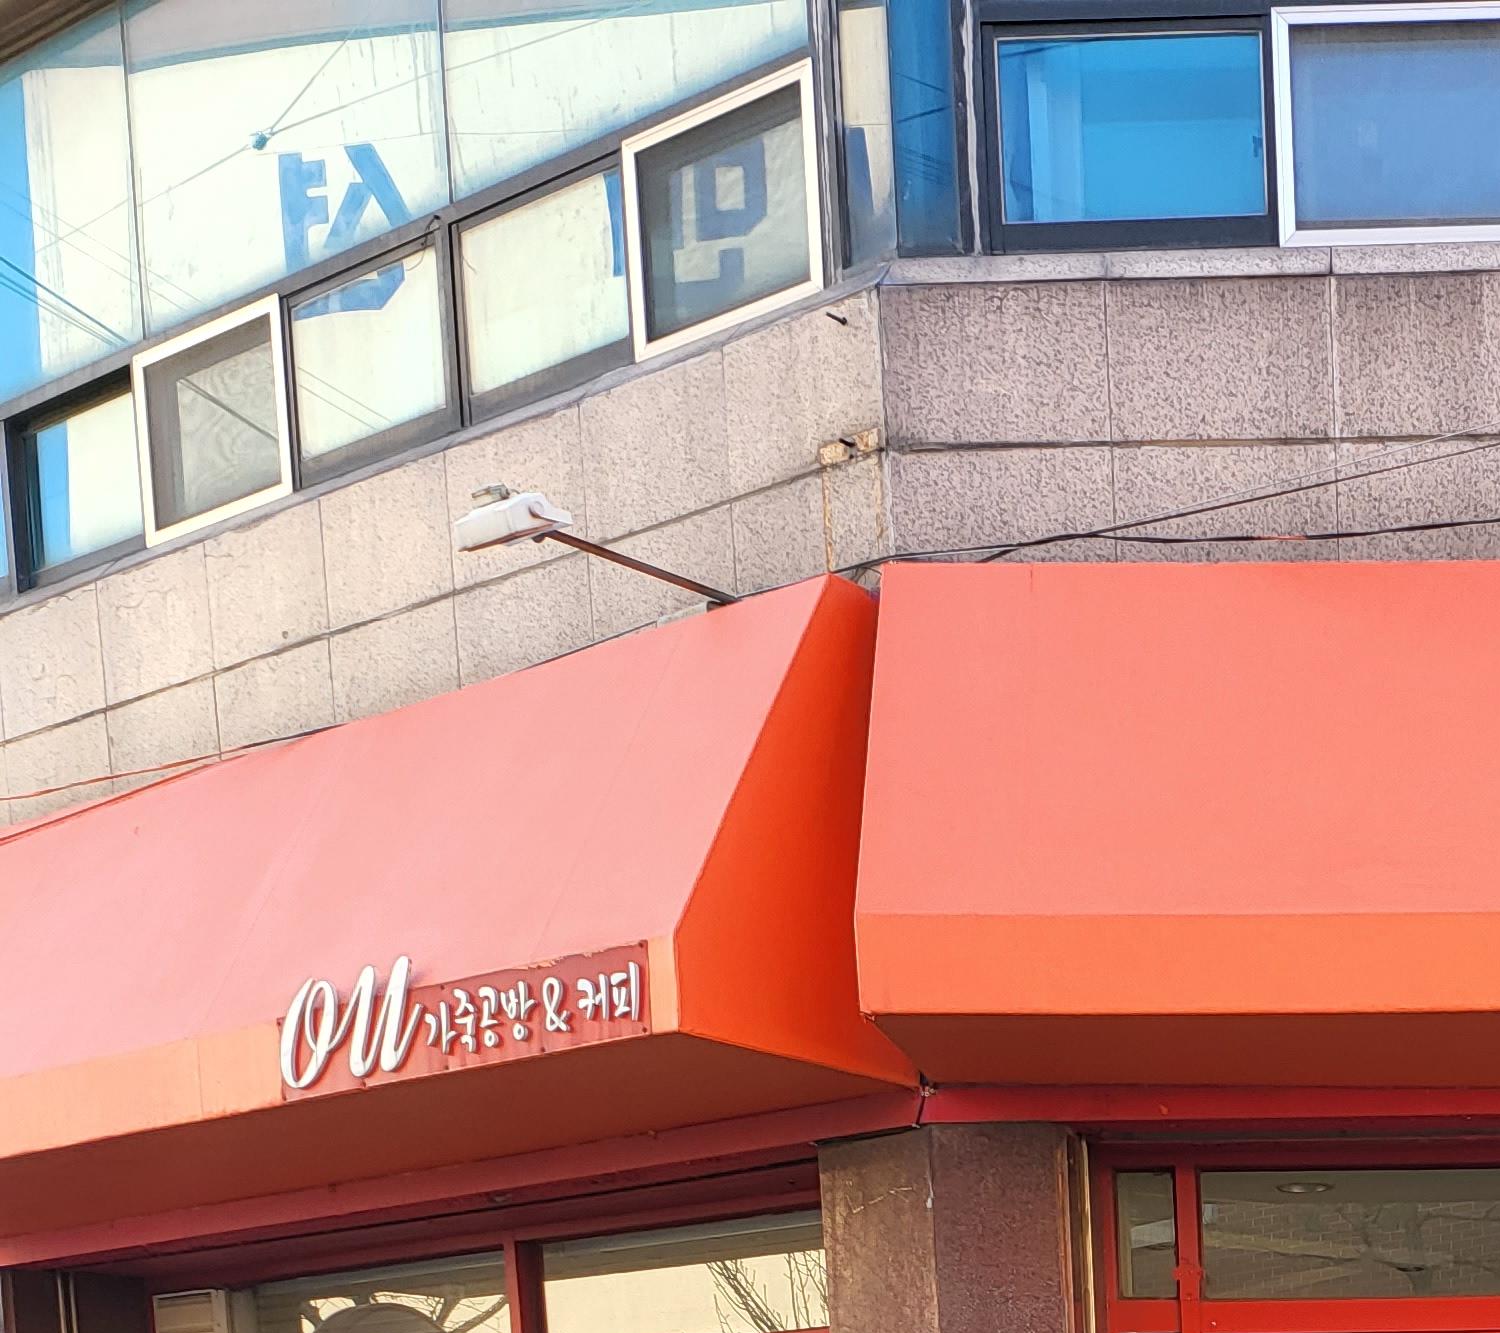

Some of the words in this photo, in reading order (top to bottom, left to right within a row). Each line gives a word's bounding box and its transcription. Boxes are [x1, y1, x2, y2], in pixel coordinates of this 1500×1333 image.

[424, 981, 534, 1055] 가죽공방
[541, 976, 571, 1033] &
[577, 960, 640, 1021] 커피
